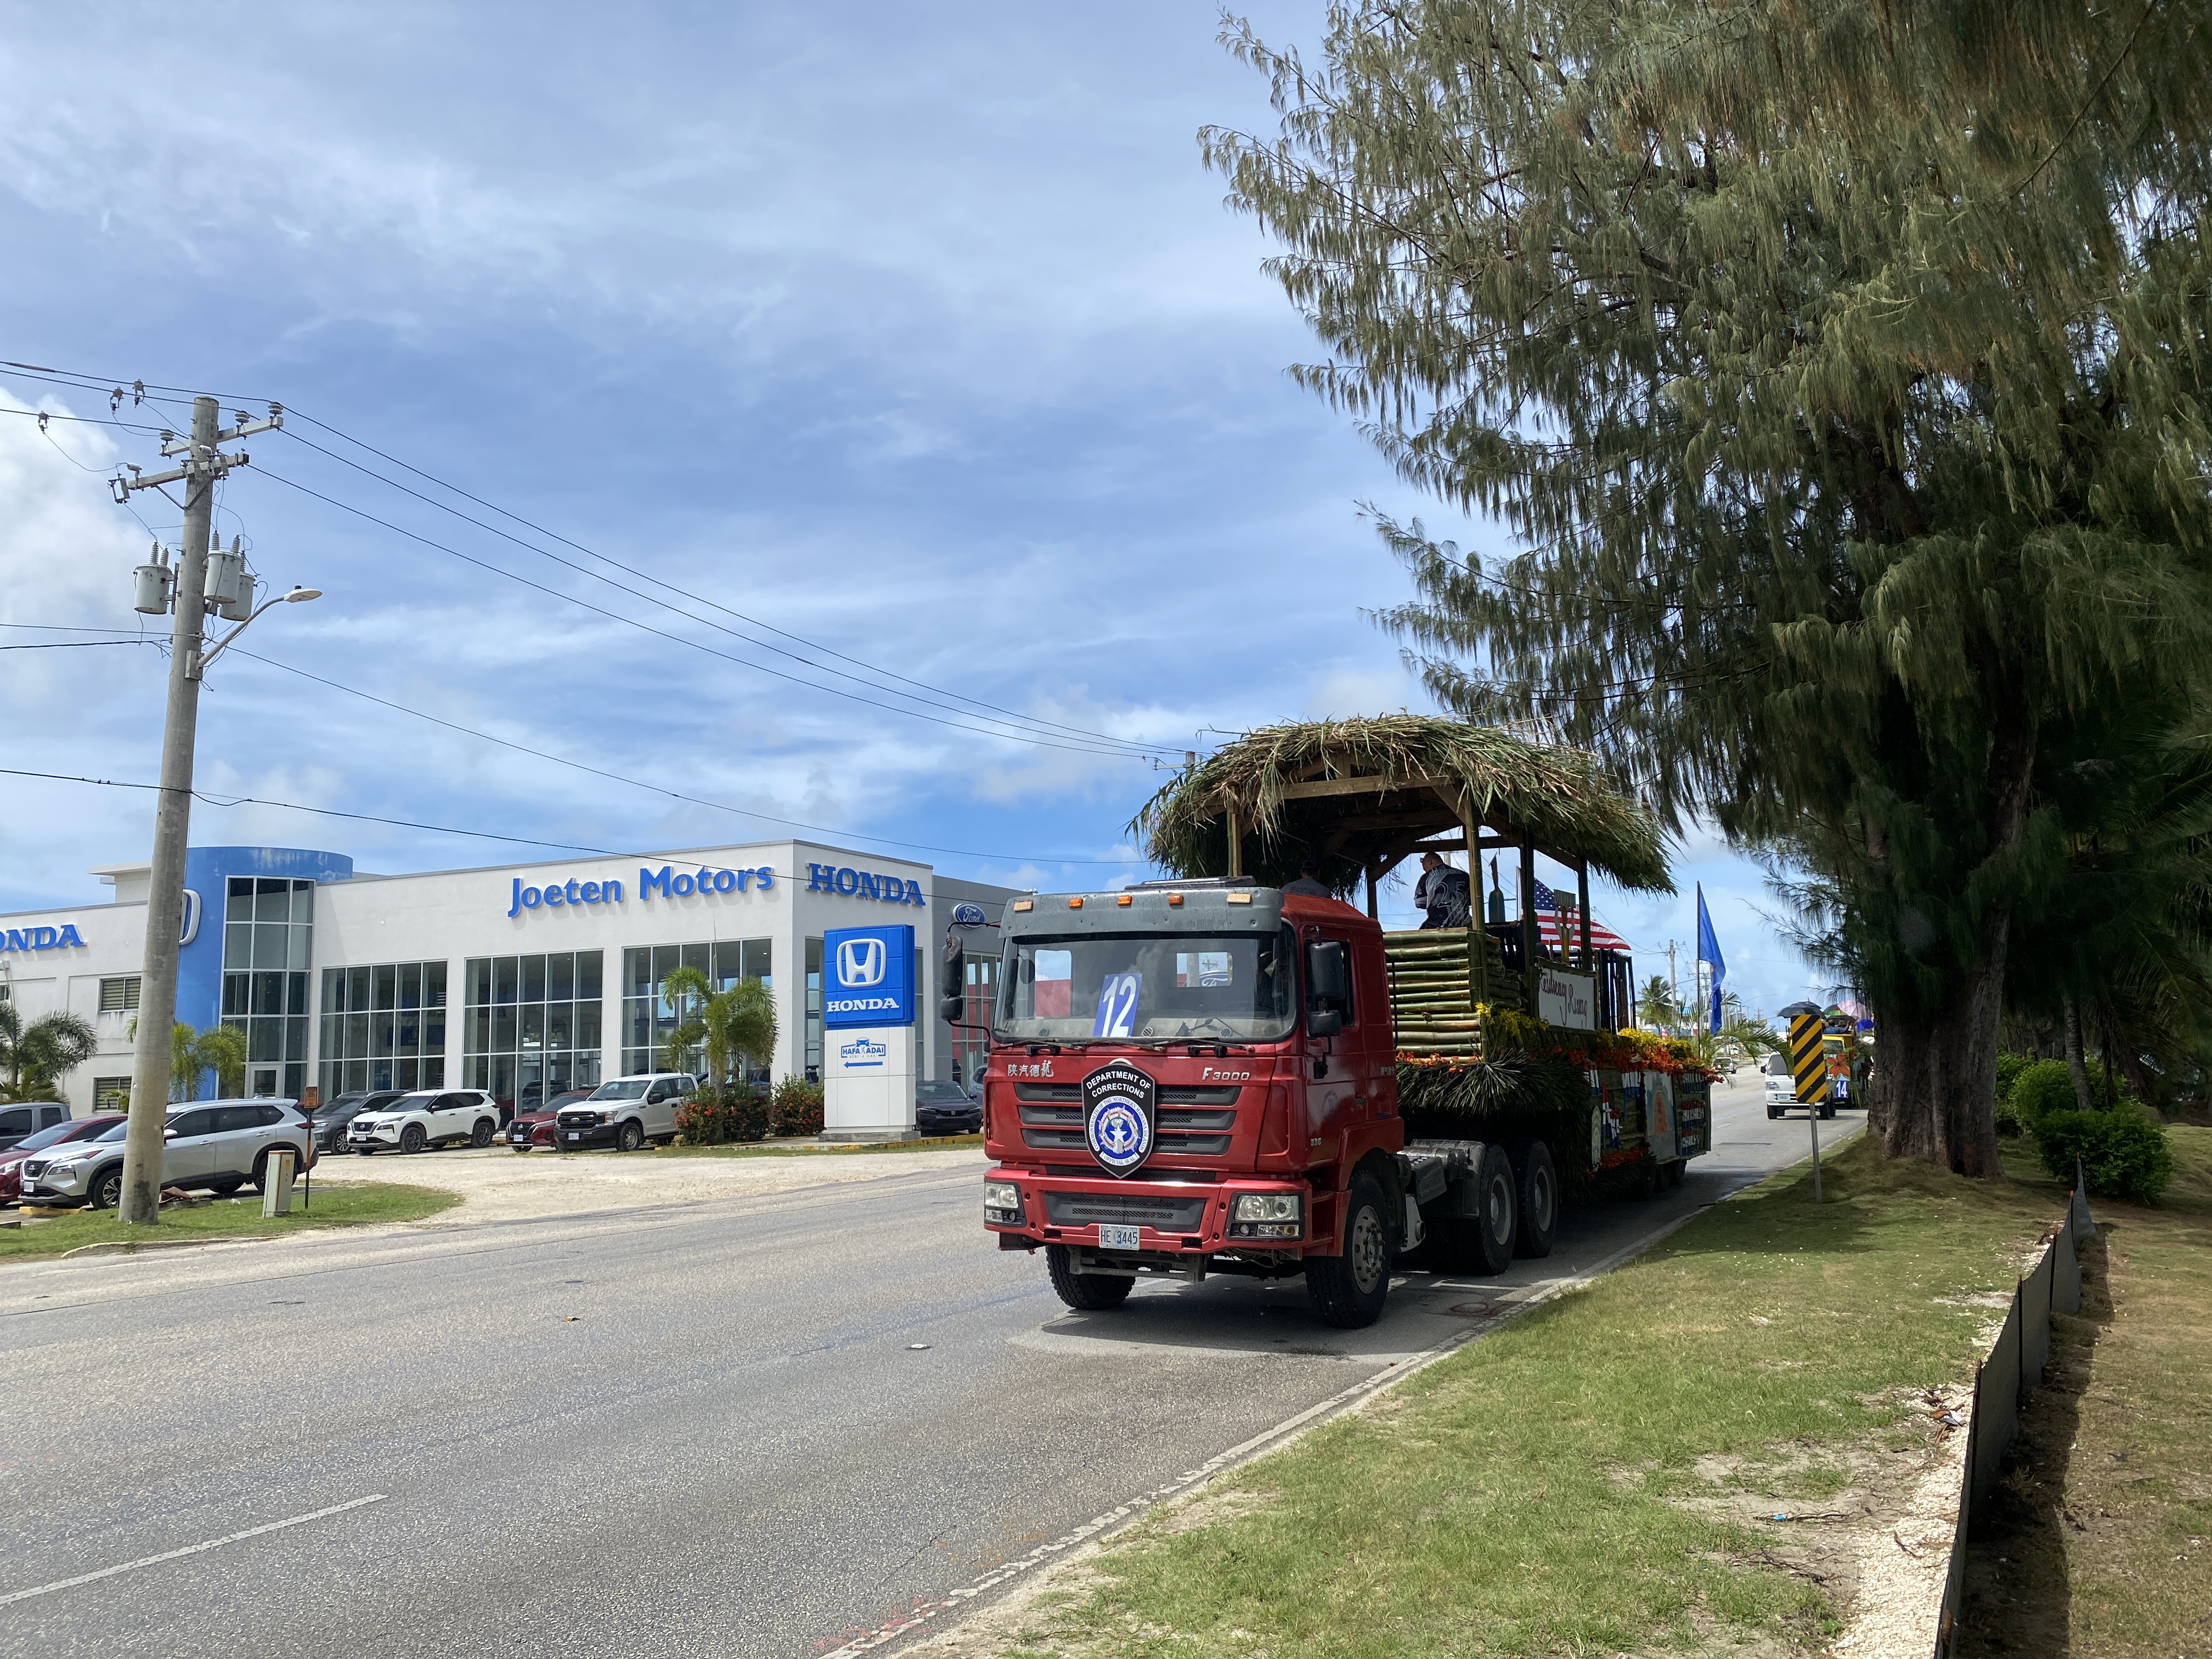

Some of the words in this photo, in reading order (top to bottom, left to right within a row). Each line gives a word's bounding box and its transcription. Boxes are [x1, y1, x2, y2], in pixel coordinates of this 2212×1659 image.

[508, 878, 623, 918] Joeten
[640, 866, 775, 900] Motors
[808, 863, 926, 906] HONDA
[1437, 882, 1466, 909] 25
[963, 906, 981, 922] Ford
[0, 924, 84, 953] NDA
[826, 997, 900, 1012] HONDA
[1102, 975, 1136, 1037] 12
[1568, 984, 1587, 1029] Rising
[1086, 1071, 1139, 1090] DEPARTMENT
[1139, 1079, 1151, 1089] OF
[1202, 1067, 1250, 1081] F3000
[1092, 1083, 1145, 1098] CORRECTIONS
[1836, 1081, 1848, 1098] 14
[1113, 1097, 1136, 1109] NORTHERN
[1136, 1107, 1148, 1131] MARIANA
[1090, 1110, 1100, 1150] COMMONWEALTH
[1139, 1131, 1148, 1151] ISLANDS
[1104, 1155, 1124, 1165] OFFICIAL
[1101, 1229, 1111, 1243] HE
[1116, 1231, 1138, 1244] 3445
